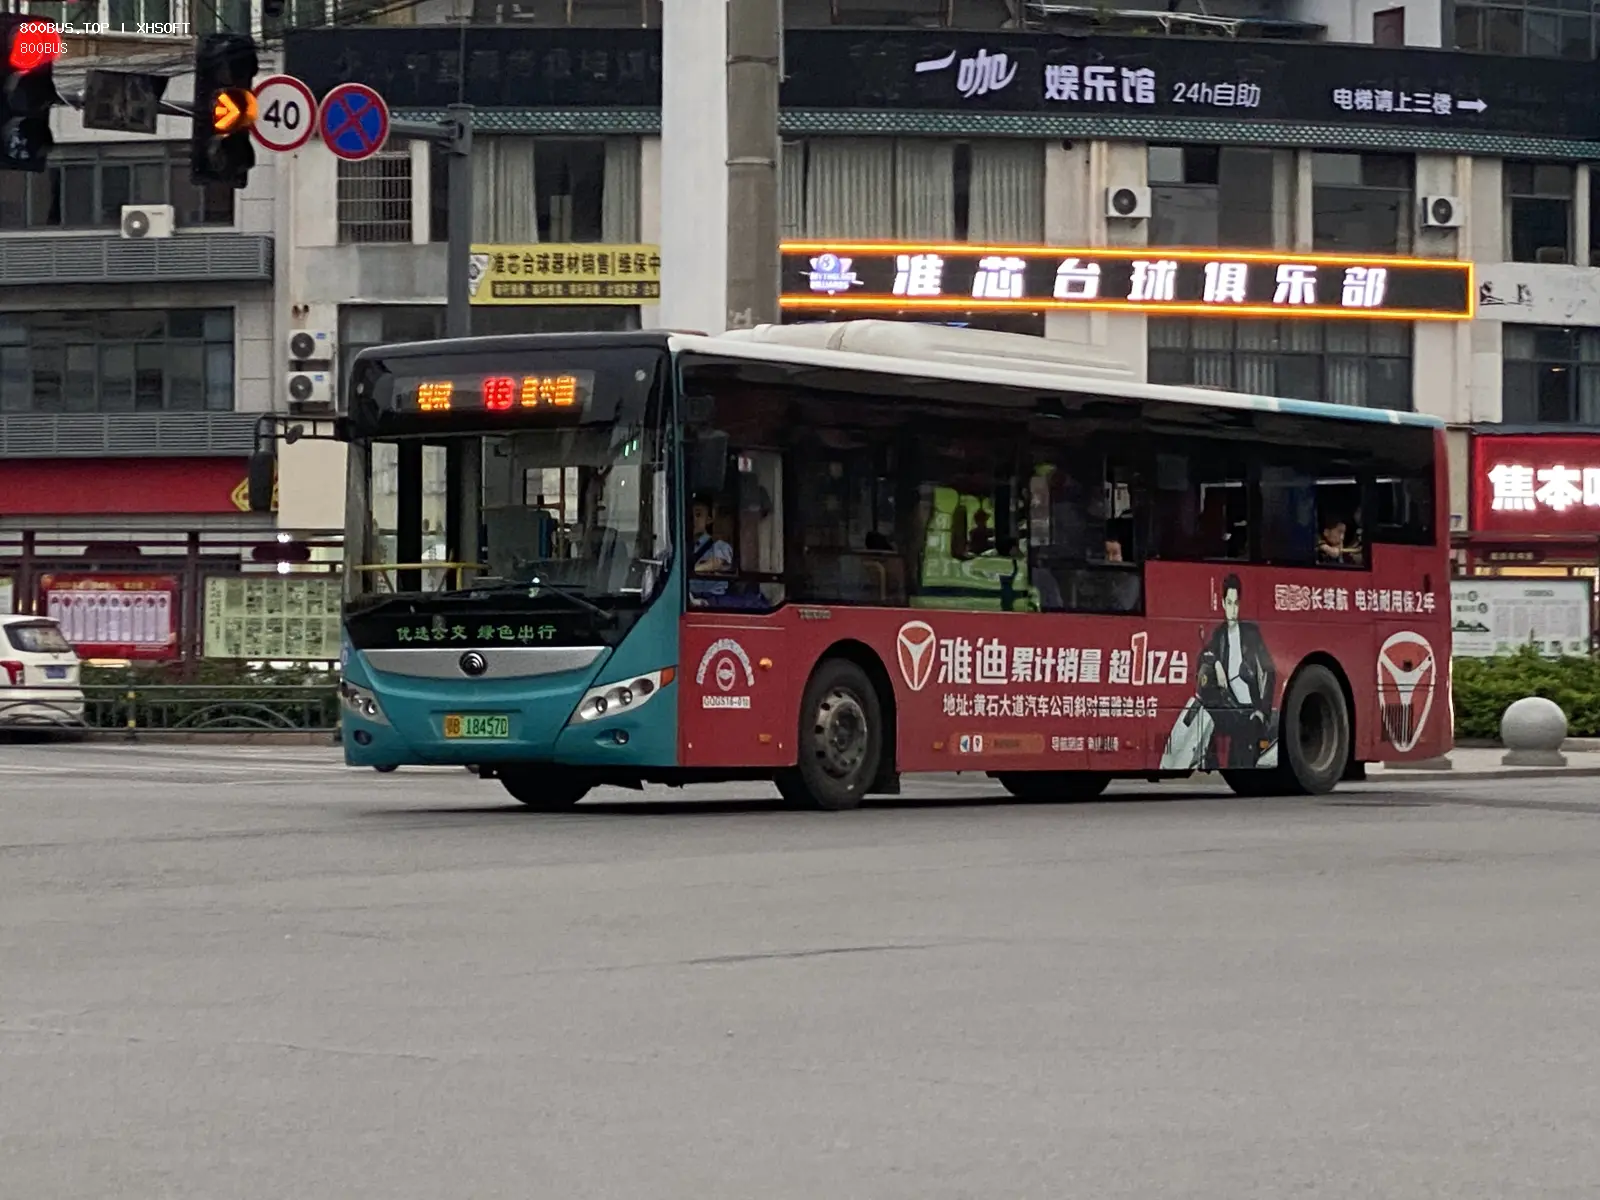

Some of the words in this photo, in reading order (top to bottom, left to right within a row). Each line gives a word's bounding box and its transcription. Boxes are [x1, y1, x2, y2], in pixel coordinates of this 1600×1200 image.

[915, 49, 1018, 98] 一咖
[1044, 64, 1156, 104] 娱乐馆
[1173, 82, 1261, 108] 24h自助
[263, 99, 300, 131] 40
[1333, 88, 1452, 115] 电梯请上三楼
[476, 624, 557, 641] 绿色出行
[1108, 631, 1189, 686] 超1亿台
